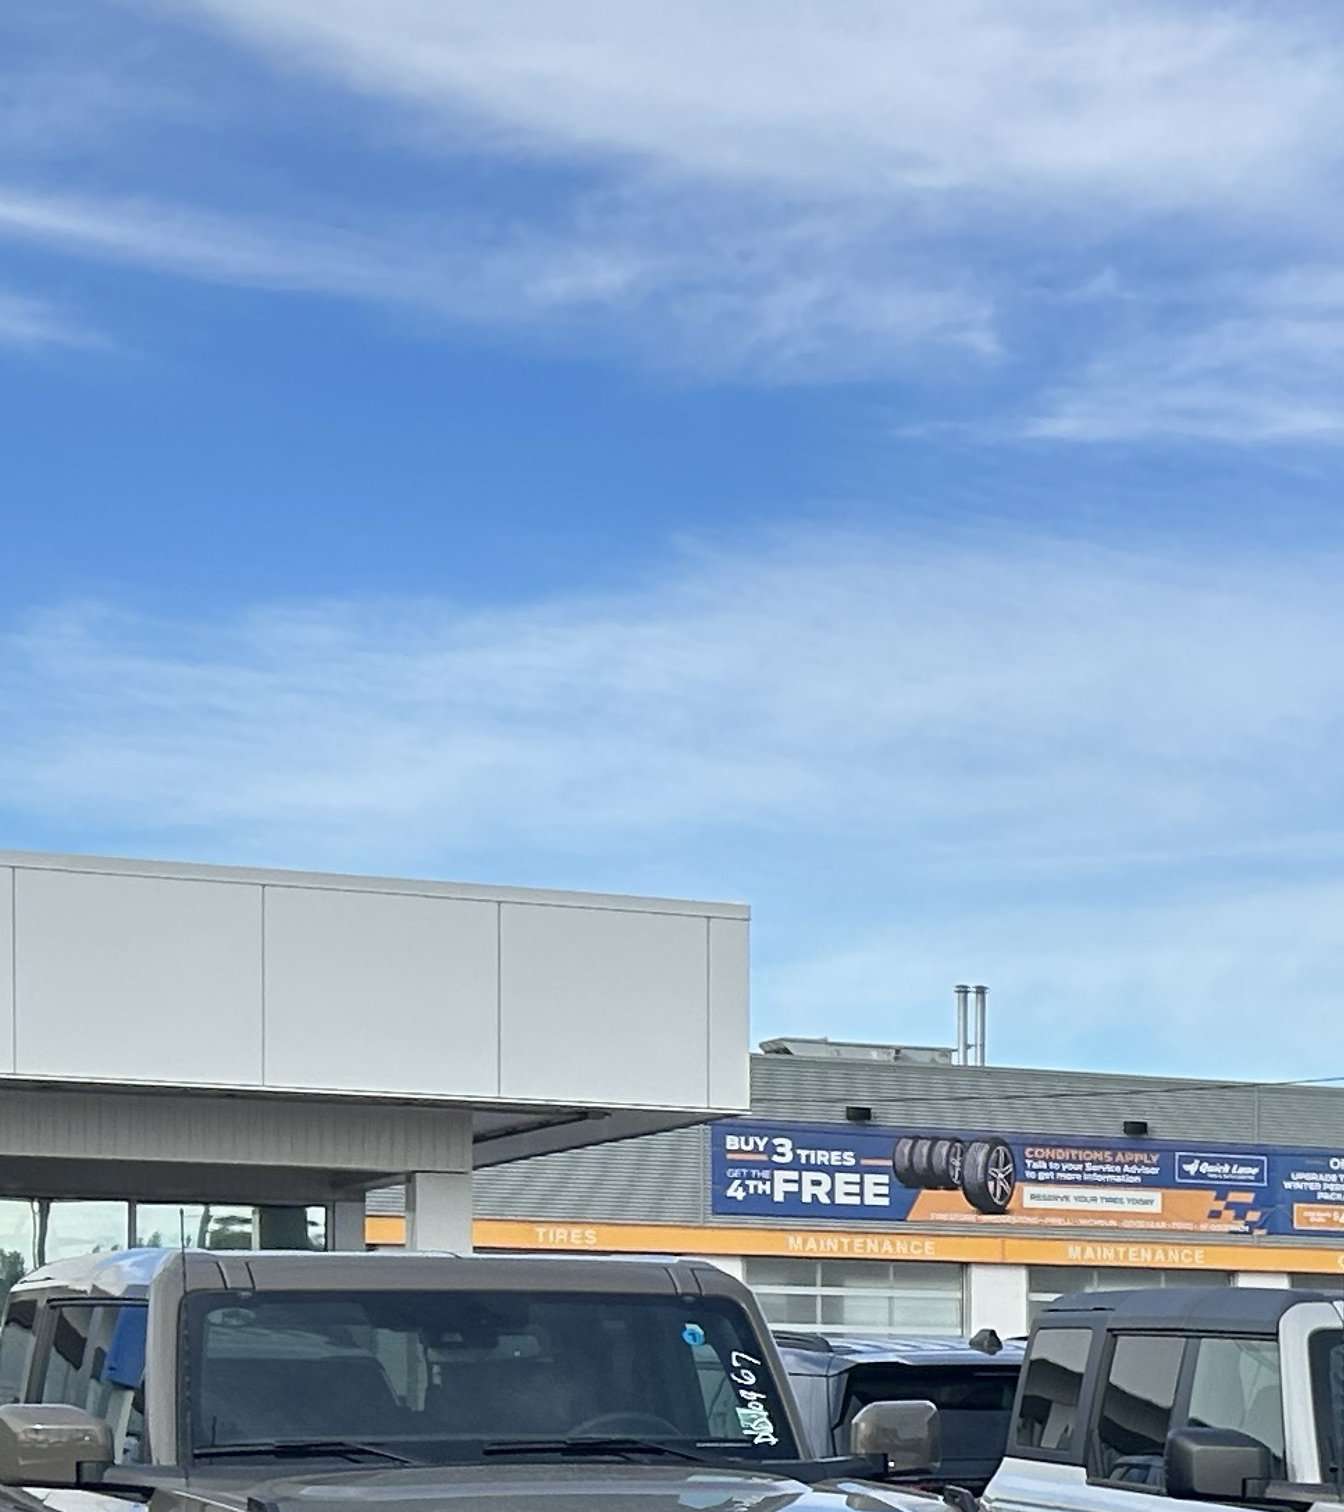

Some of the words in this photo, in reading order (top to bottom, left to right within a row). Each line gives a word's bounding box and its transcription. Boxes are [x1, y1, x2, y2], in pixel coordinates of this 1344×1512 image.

[725, 1134, 769, 1151] BUY
[771, 1137, 794, 1163] 3
[796, 1148, 856, 1166] TIRES
[1024, 1147, 1113, 1162] CONDITIONS
[1115, 1153, 1161, 1164] APPLY
[726, 1168, 748, 1178] GET
[750, 1169, 771, 1179] THE
[1025, 1159, 1047, 1170] Talk
[1049, 1160, 1060, 1171] to
[1061, 1162, 1084, 1173] your
[1084, 1162, 1121, 1173] Service
[726, 1179, 771, 1201] 4TH
[773, 1170, 891, 1206] FREE
[535, 1227, 597, 1245] TIRES
[787, 1236, 936, 1256] MAINTENANCE
[1067, 1245, 1205, 1264] MAINTENANCE
